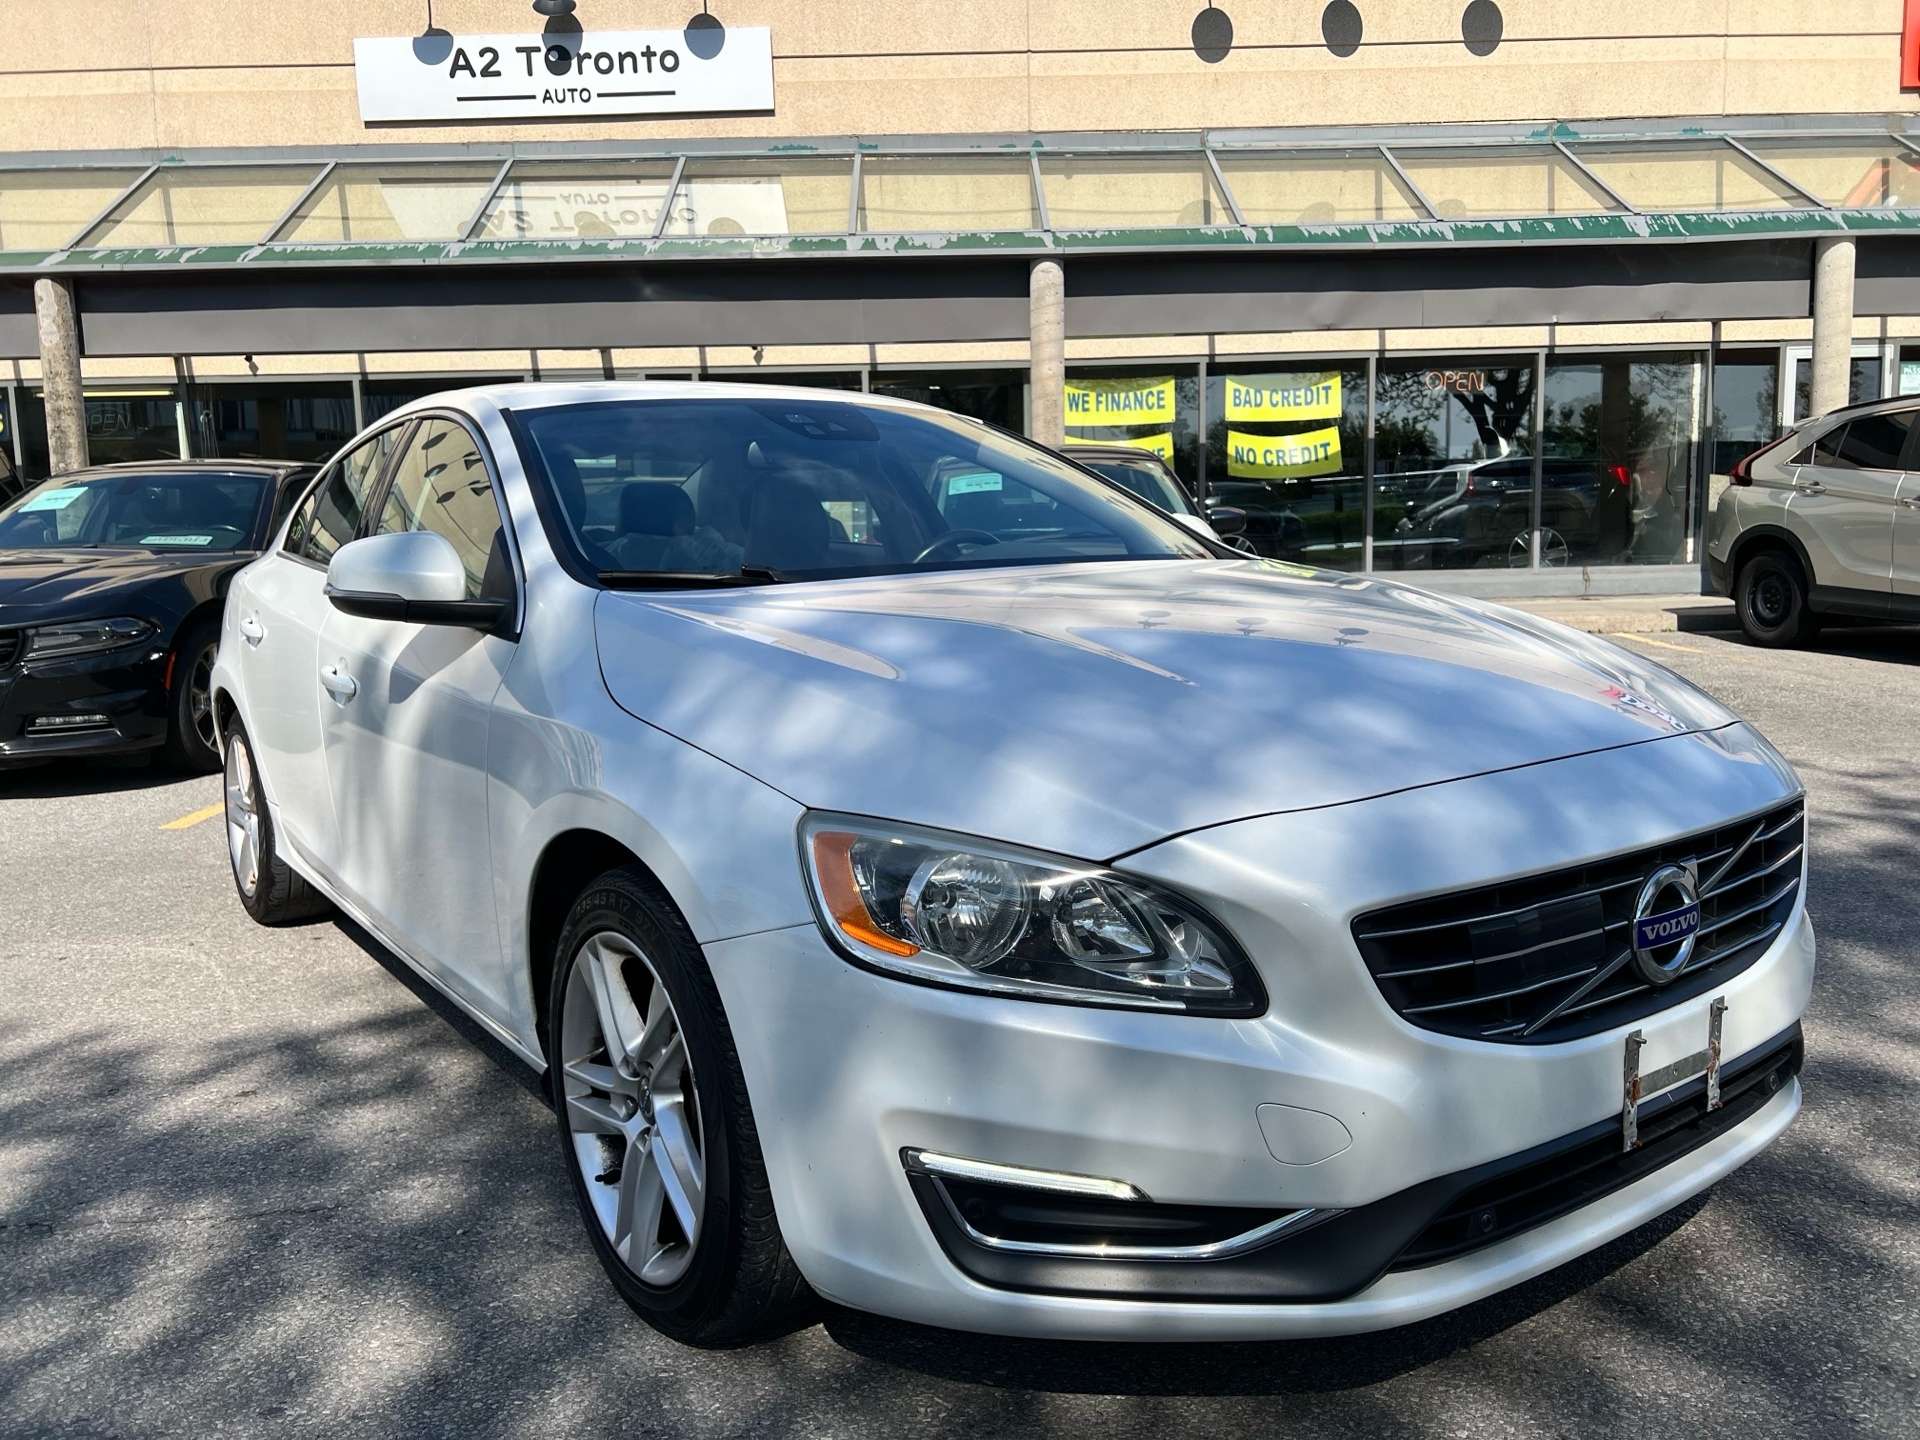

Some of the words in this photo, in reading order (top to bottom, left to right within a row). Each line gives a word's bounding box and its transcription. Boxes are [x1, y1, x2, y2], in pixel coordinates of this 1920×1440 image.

[449, 46, 502, 78] A2
[515, 44, 680, 77] Toronto
[542, 87, 592, 104] AUTO
[1425, 371, 1485, 391] OPEN
[1067, 392, 1090, 412] WE
[1095, 389, 1166, 412] FINANCE
[1233, 388, 1263, 408] BAD
[1269, 385, 1332, 407] CREDIT
[86, 413, 130, 431] PEN
[1234, 445, 1257, 465] NO
[1263, 442, 1331, 466] CREDIT
[1642, 911, 1698, 940] VOLVO
